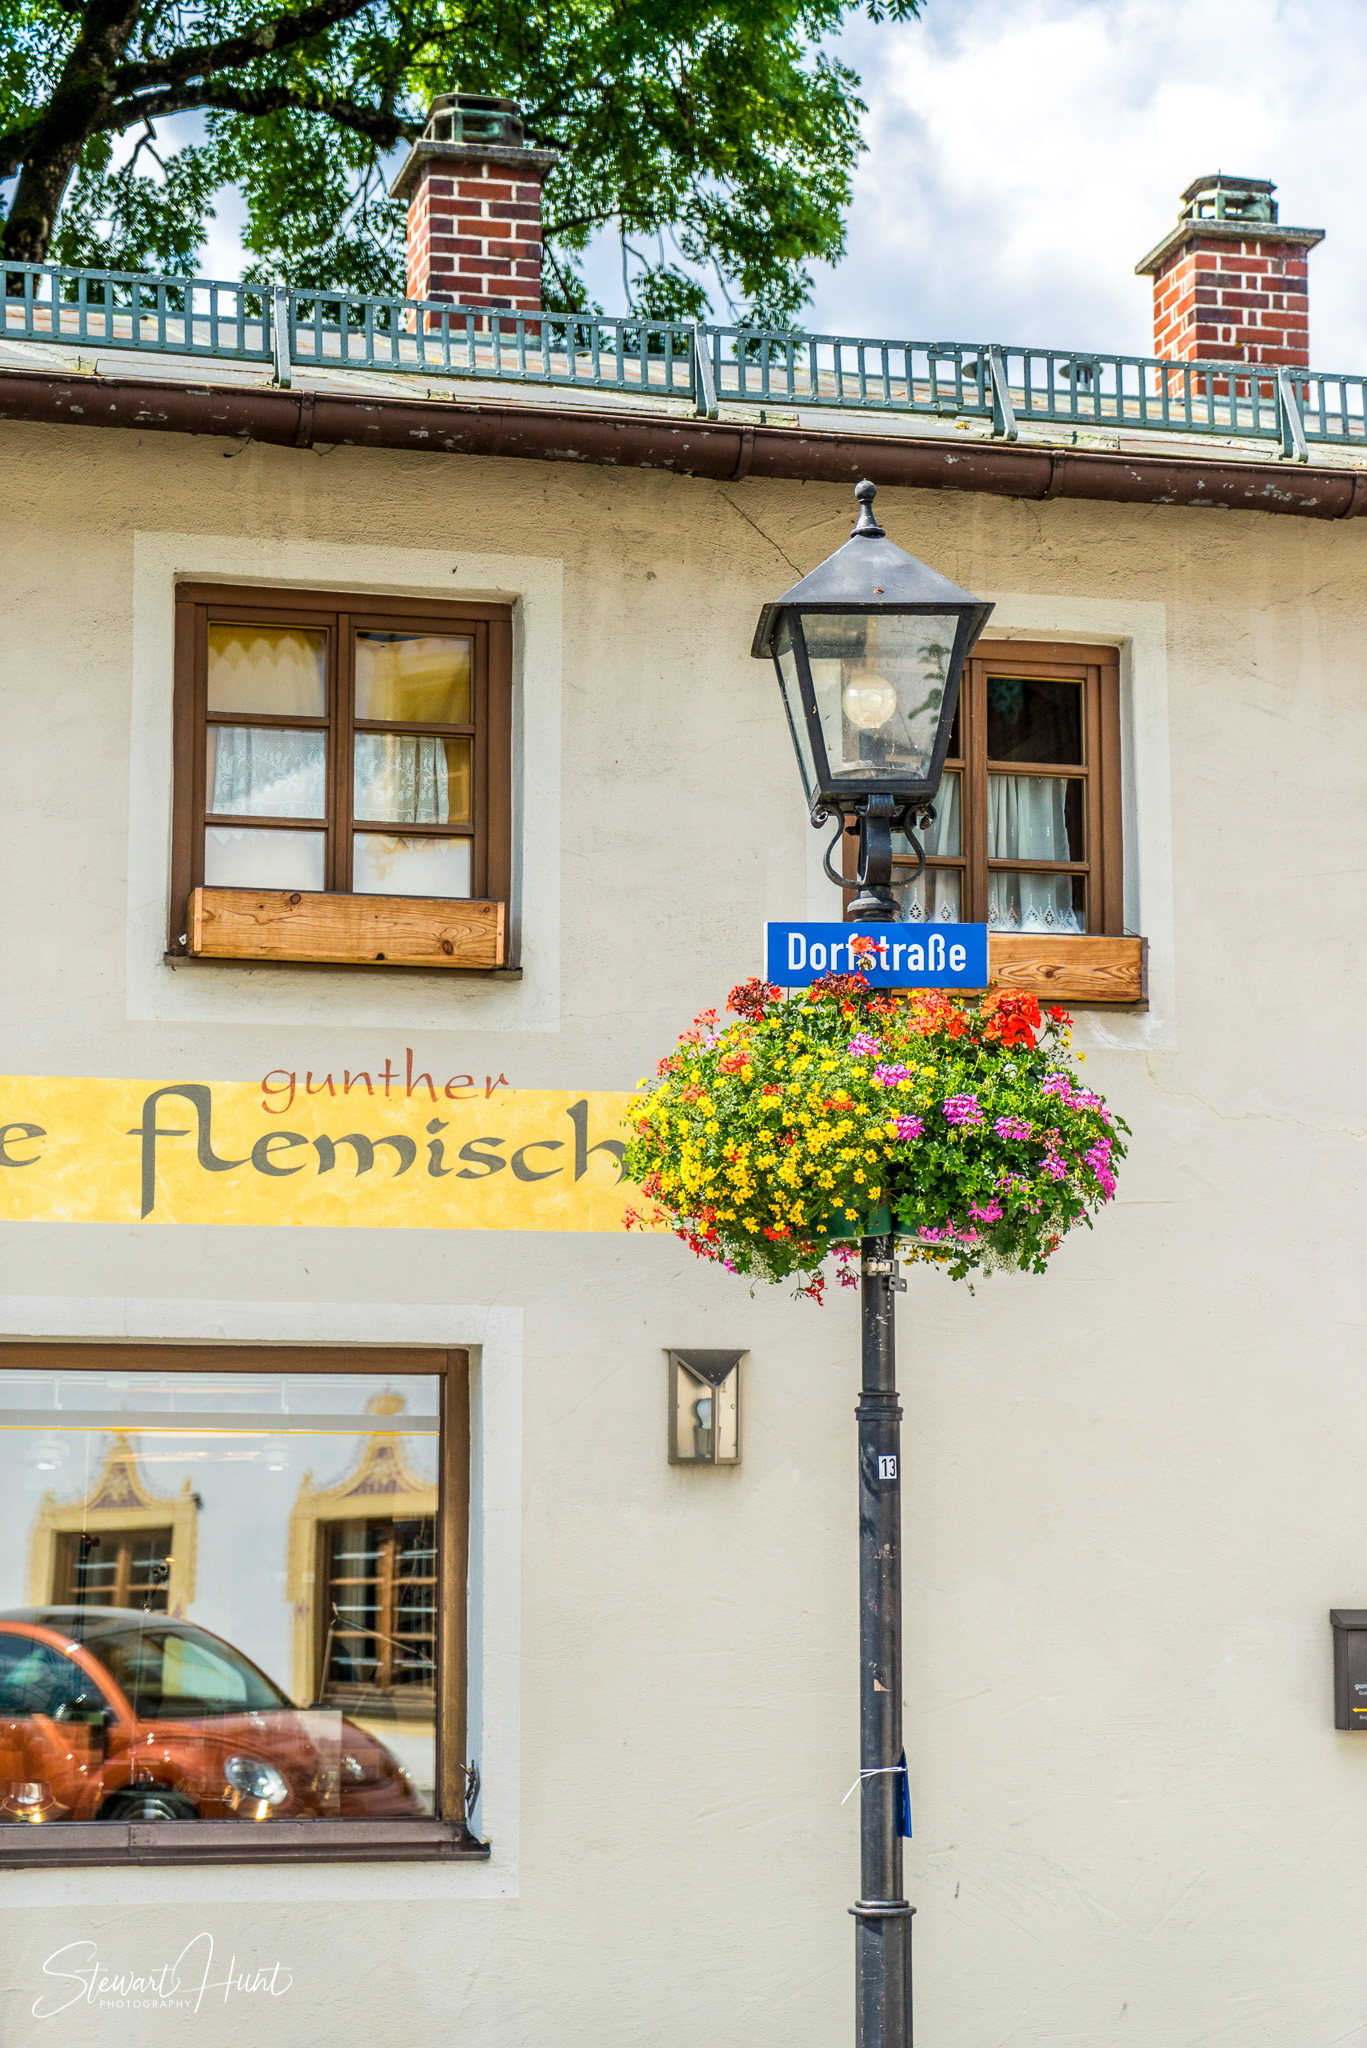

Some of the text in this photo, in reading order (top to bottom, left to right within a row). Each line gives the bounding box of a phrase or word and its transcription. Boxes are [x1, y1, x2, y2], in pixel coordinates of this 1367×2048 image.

[261, 1048, 510, 1115] gunther
[126, 1084, 630, 1220] flemisch
[881, 1458, 896, 1477] 13
